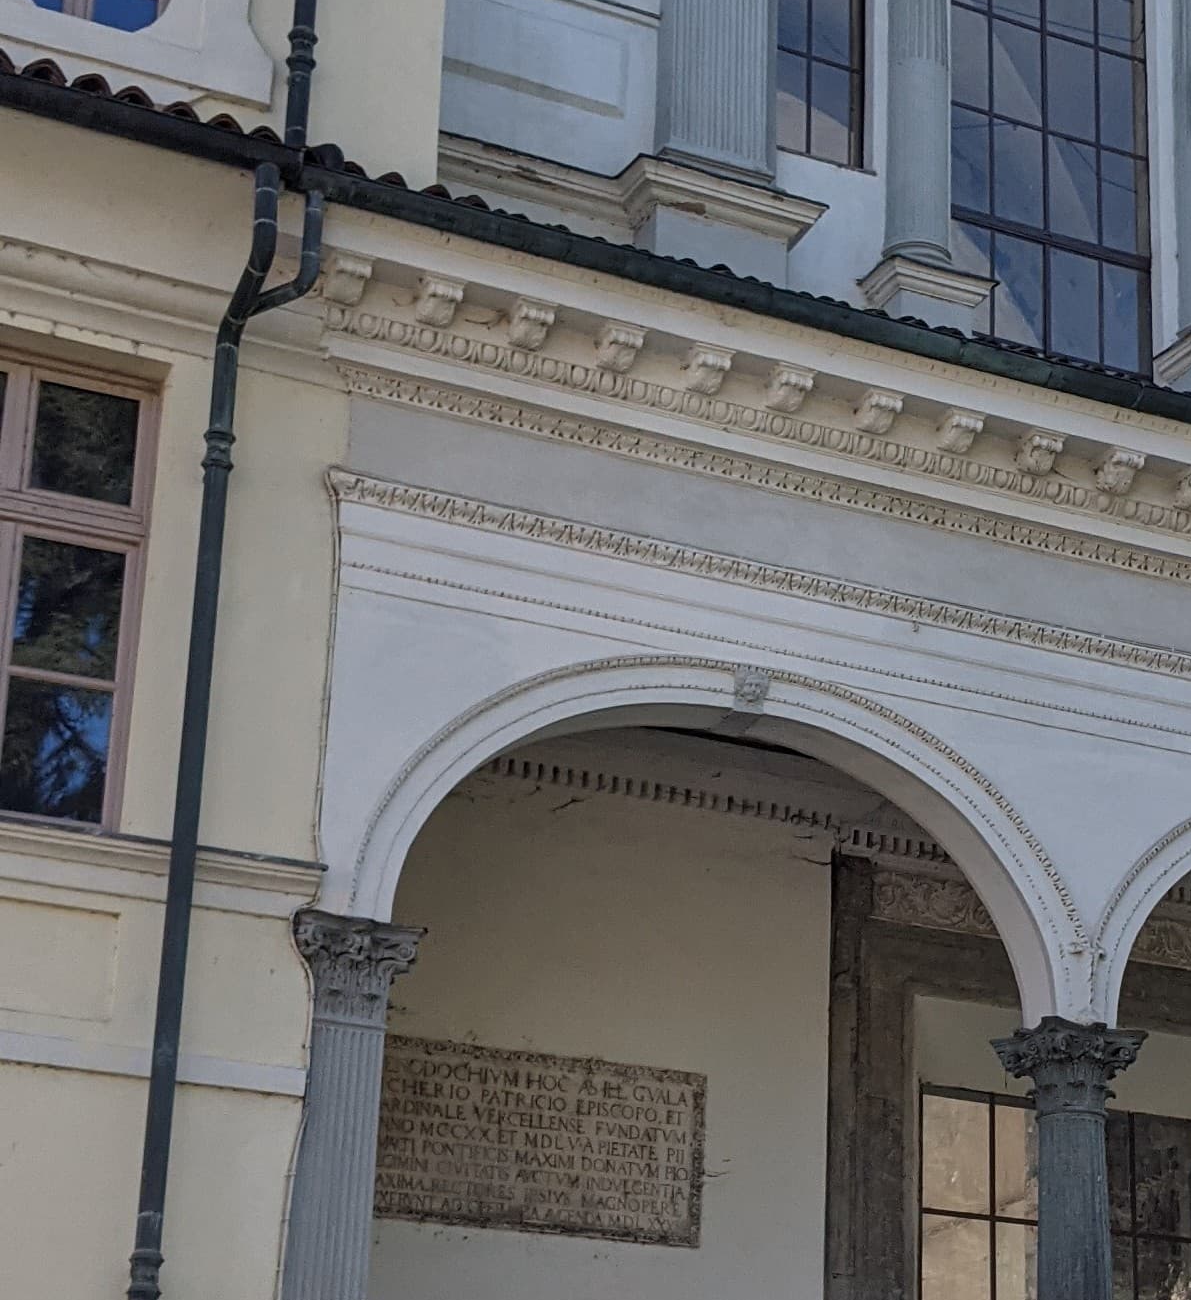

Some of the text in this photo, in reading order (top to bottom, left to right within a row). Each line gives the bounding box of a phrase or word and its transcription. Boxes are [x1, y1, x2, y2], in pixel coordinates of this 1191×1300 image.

[386, 1075, 470, 1102] CHERIO
[480, 1086, 567, 1114] PATRICIO
[666, 1109, 685, 1127] ET
[526, 1070, 568, 1094] HOC
[632, 1084, 688, 1108] GVALA
[381, 1095, 467, 1121] ARDINALE
[598, 1139, 658, 1161] PIETATE
[580, 1155, 660, 1179] DONATVM
